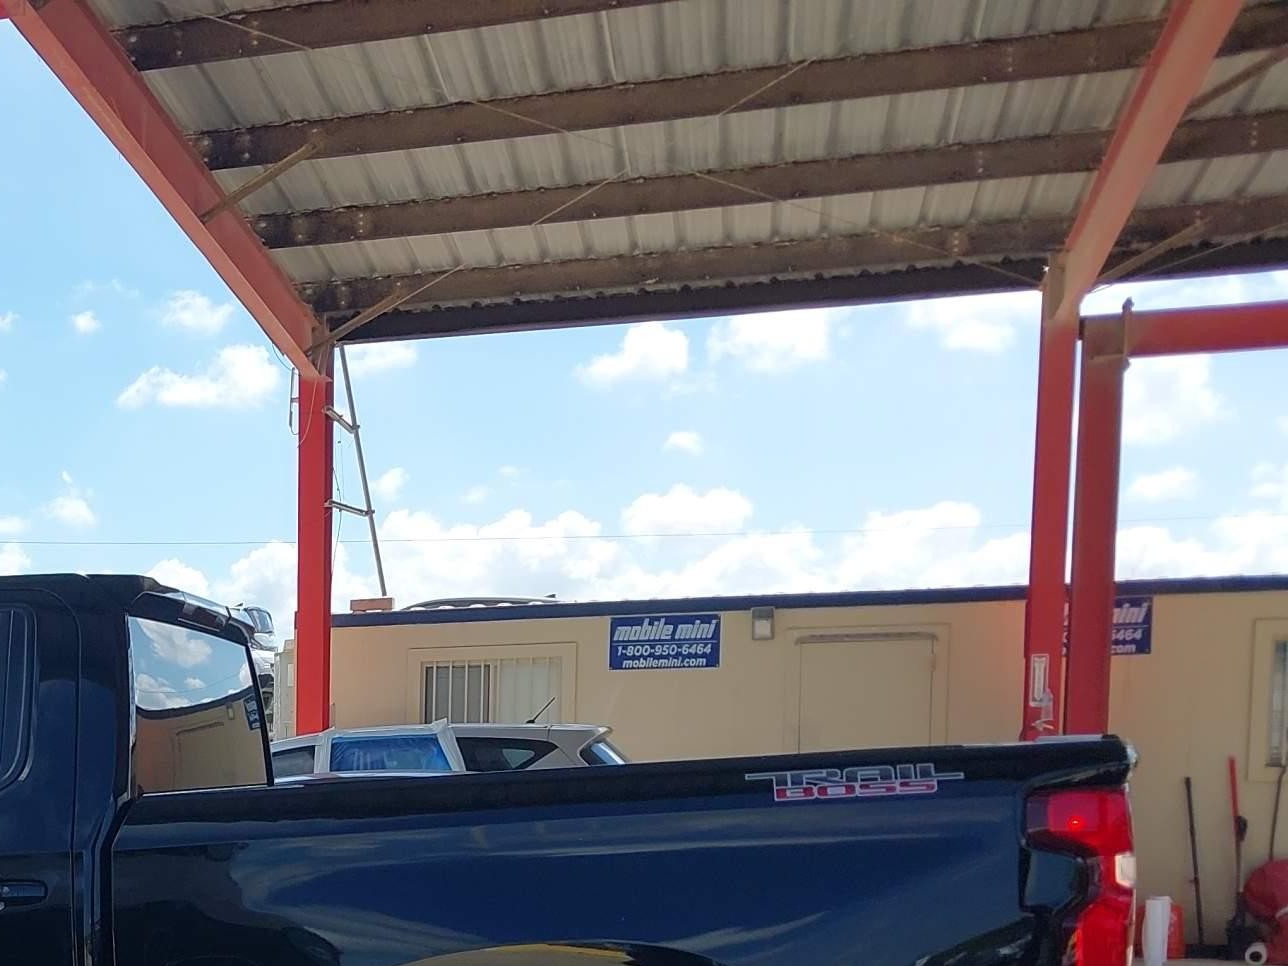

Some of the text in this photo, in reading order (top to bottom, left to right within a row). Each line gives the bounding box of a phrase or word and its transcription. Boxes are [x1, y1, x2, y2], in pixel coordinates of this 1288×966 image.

[613, 618, 719, 641] mobile mini
[617, 643, 712, 657] 1-800-950-6464
[622, 657, 707, 669] mobilemini.com
[745, 763, 965, 788] TRAIL
[774, 778, 938, 801] BOSS
